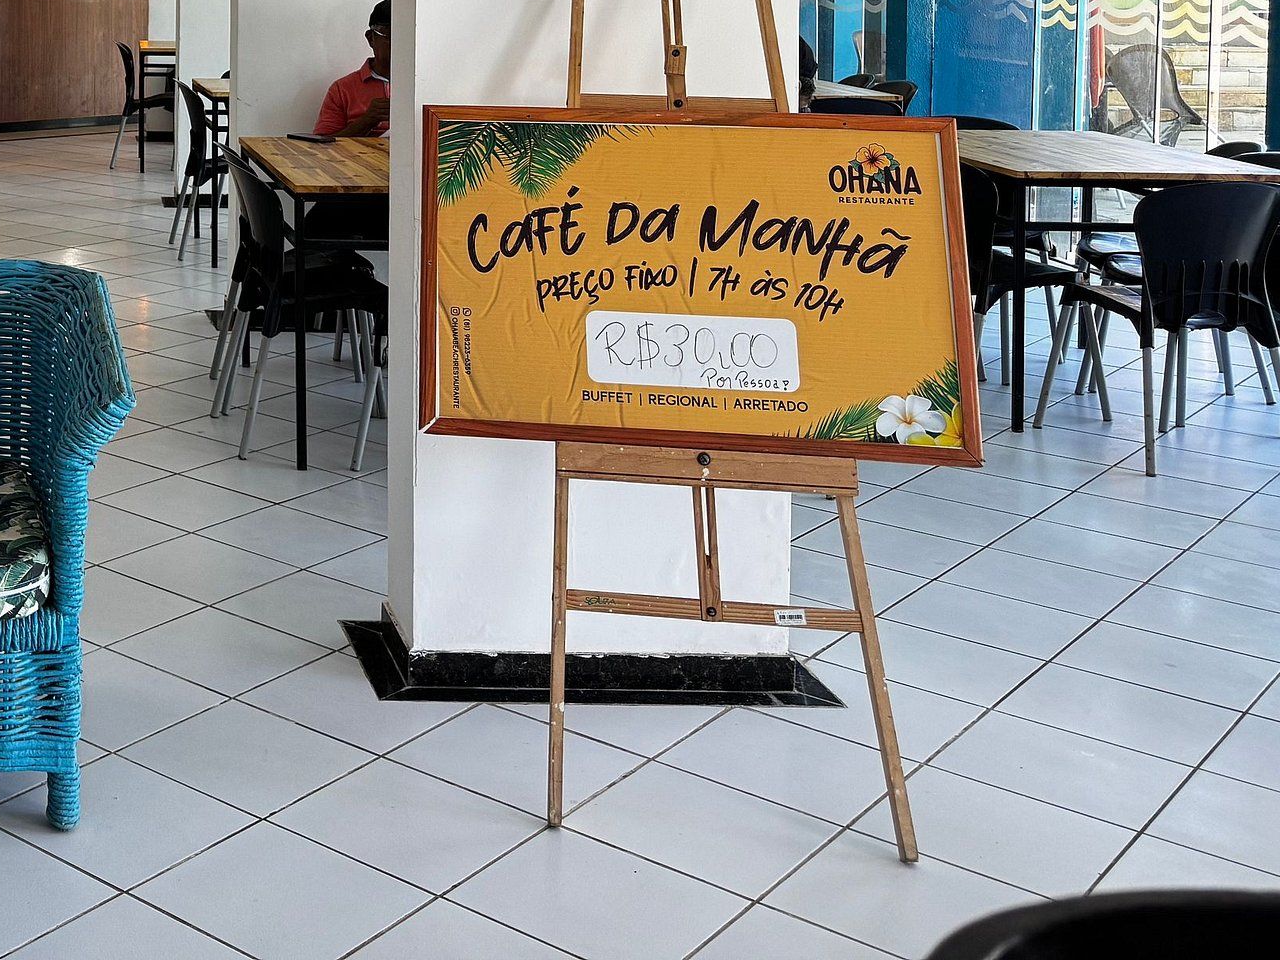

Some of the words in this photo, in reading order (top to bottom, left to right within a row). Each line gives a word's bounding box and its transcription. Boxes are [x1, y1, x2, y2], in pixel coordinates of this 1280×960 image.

[828, 164, 922, 195] OHANA
[838, 196, 915, 206] RESTAURANTE
[535, 267, 615, 314] PREÇO
[793, 282, 845, 322] 10H
[581, 389, 633, 405] BUFFET
[648, 393, 718, 409] REGIONAL
[733, 398, 809, 413] ARRETADO
